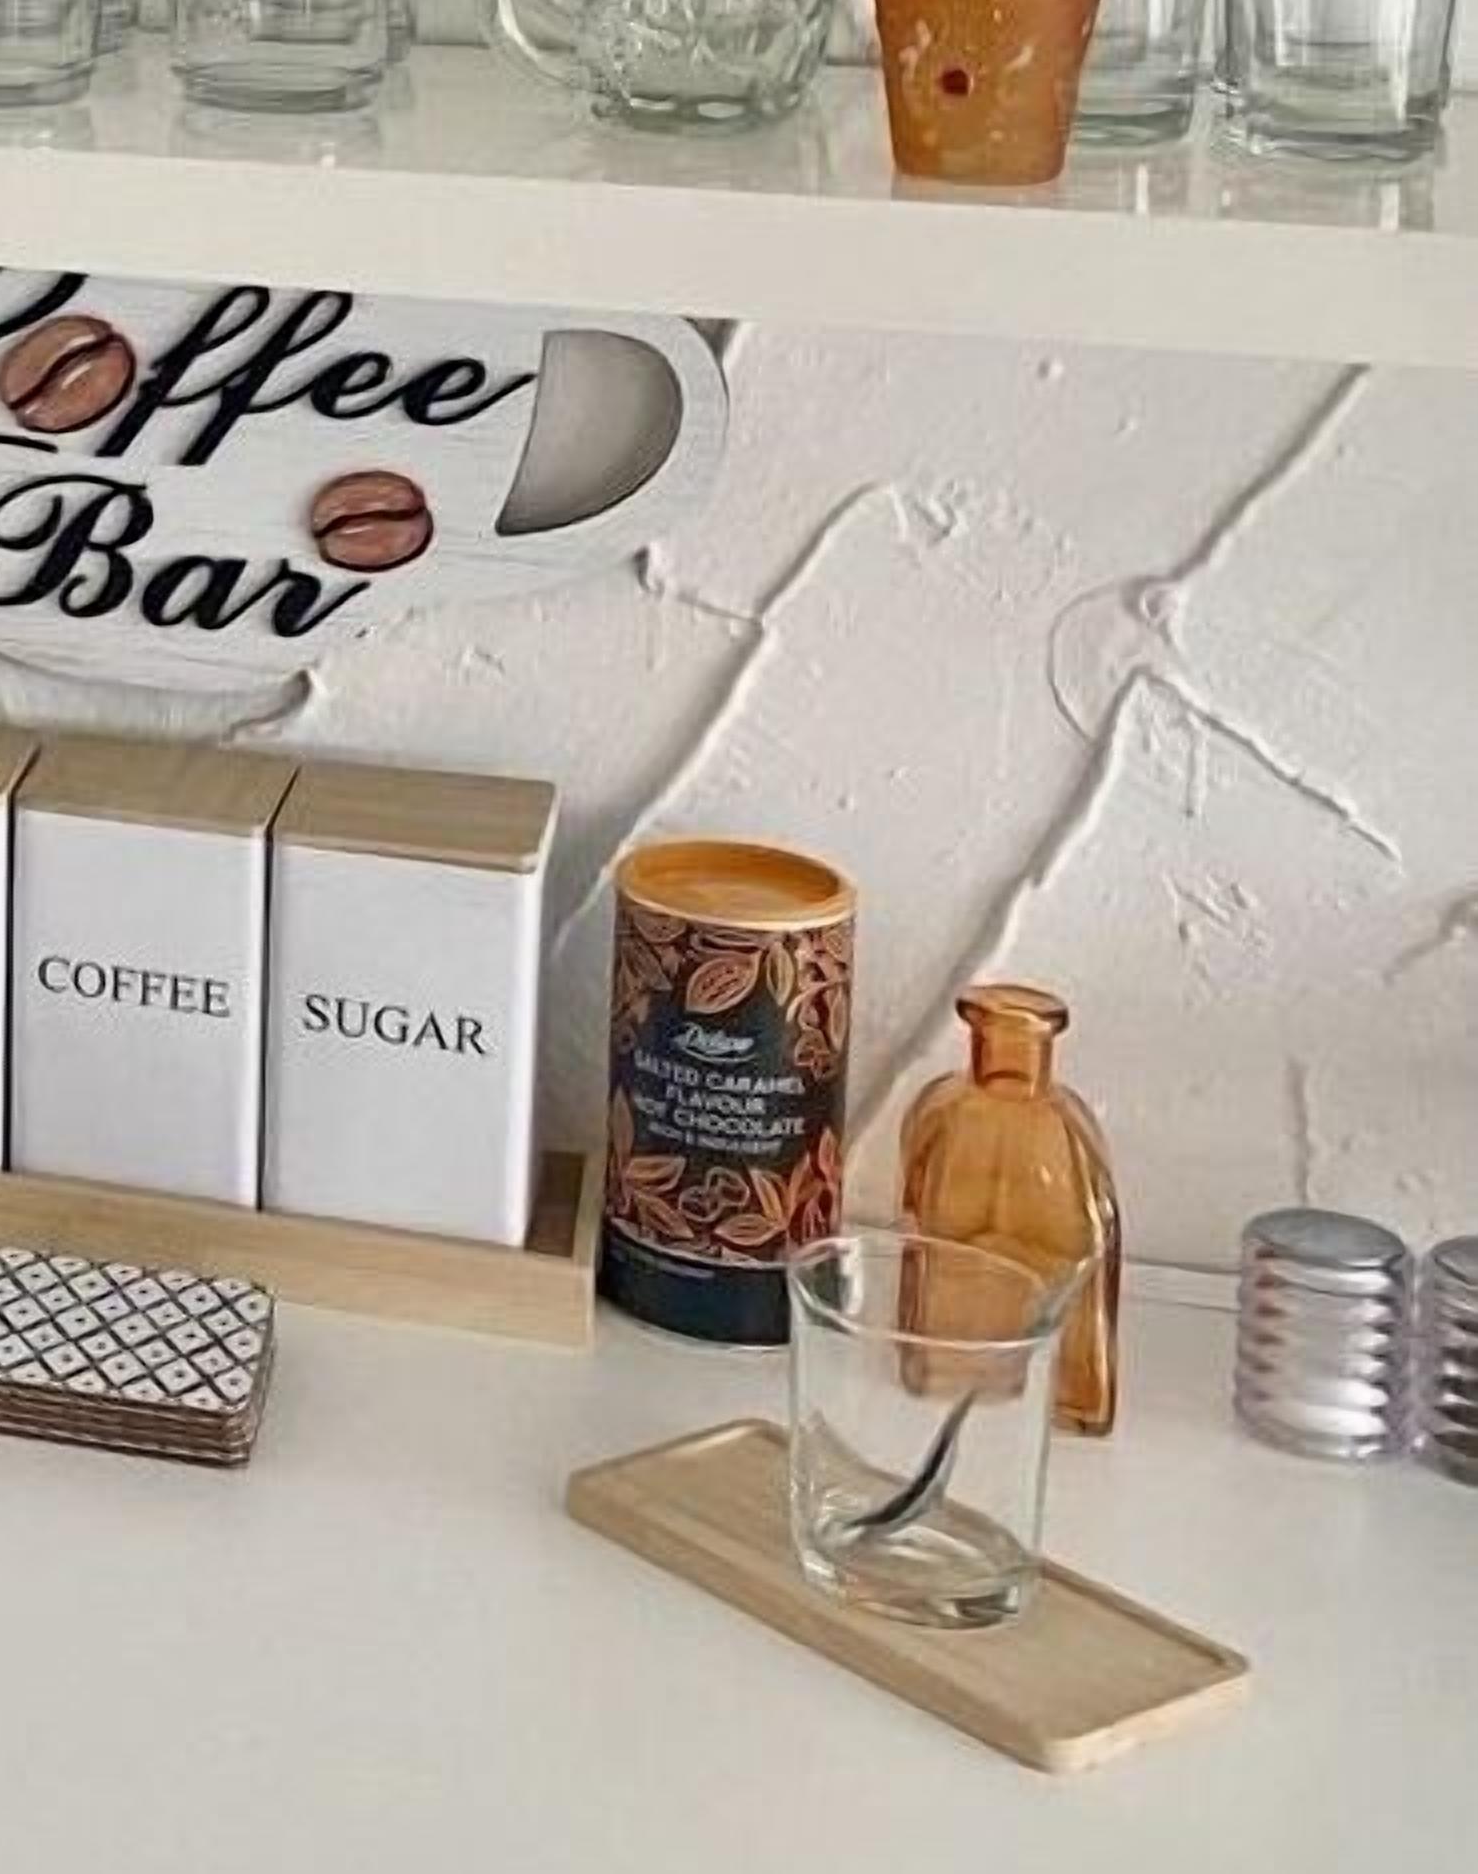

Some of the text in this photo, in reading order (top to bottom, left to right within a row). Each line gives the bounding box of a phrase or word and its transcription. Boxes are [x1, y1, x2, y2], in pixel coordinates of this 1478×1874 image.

[36, 955, 231, 1019] COFFEE
[302, 992, 491, 1057] SUGAR
[705, 1071, 806, 1096] CARAMEL
[666, 1084, 766, 1116] FLAVOUR
[674, 1108, 806, 1137] CHOCOLATE
